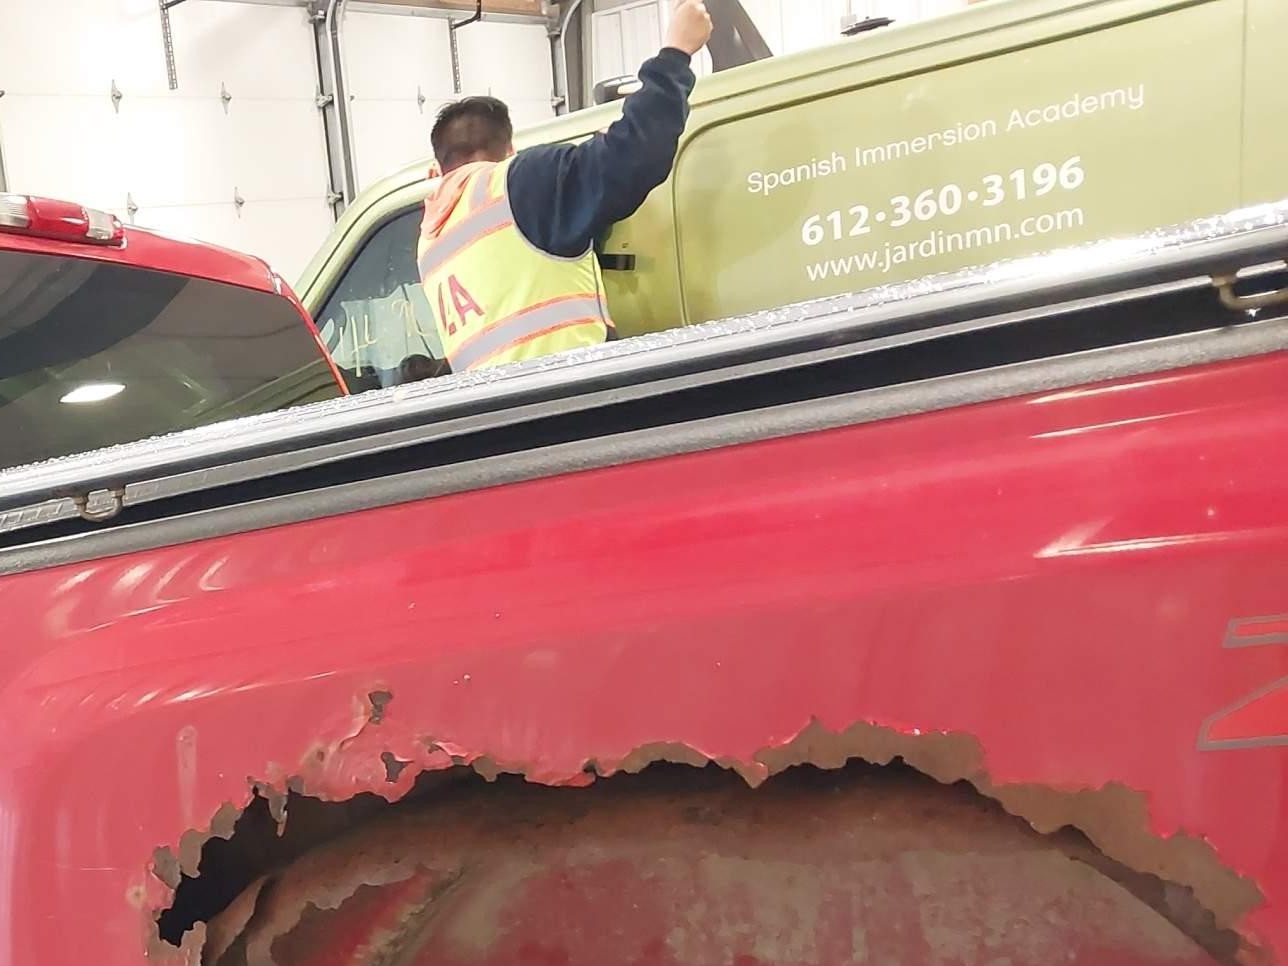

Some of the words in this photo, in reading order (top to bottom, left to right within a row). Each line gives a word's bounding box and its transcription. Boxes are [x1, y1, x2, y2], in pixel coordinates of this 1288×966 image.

[747, 151, 846, 196] Spanish
[855, 118, 997, 168] Immersion
[1006, 83, 1146, 132] Academy
[806, 206, 1085, 282] www.jardinmn.com
